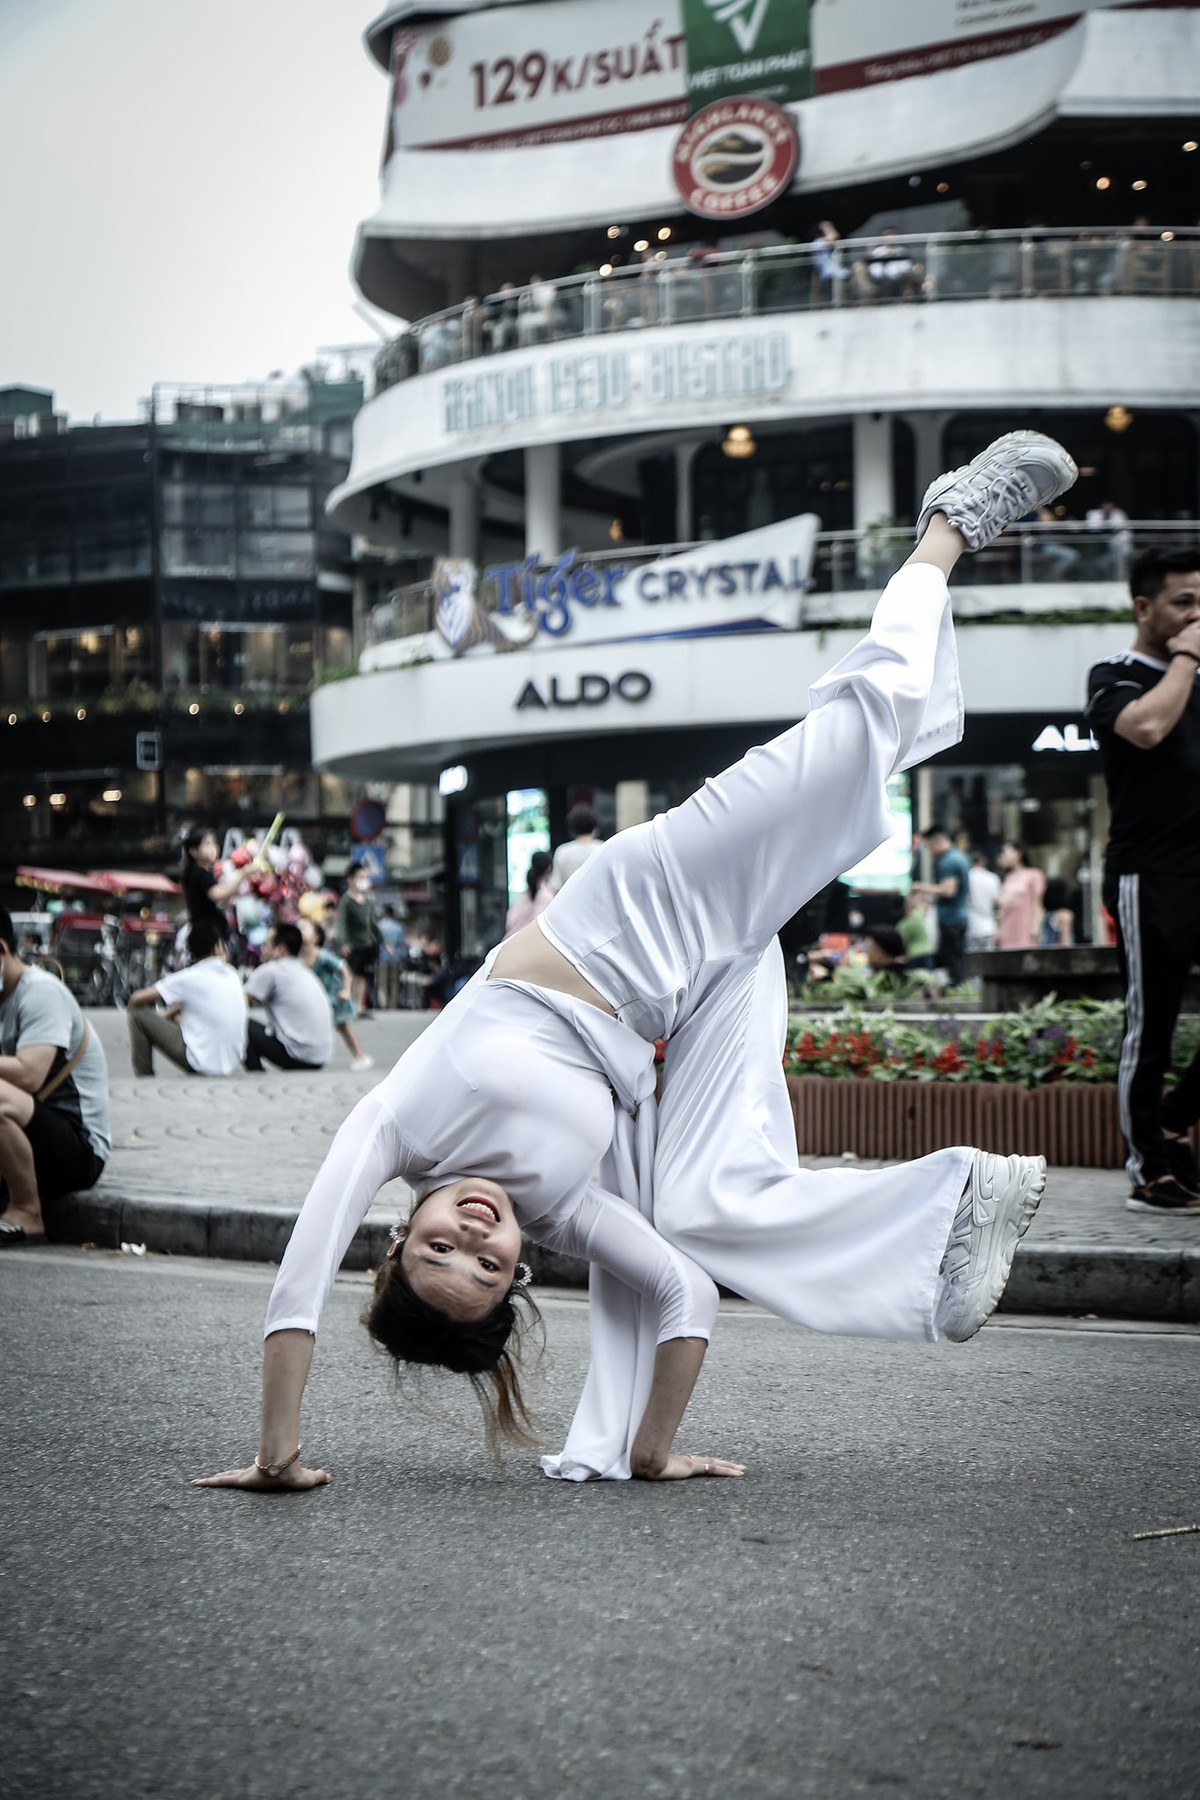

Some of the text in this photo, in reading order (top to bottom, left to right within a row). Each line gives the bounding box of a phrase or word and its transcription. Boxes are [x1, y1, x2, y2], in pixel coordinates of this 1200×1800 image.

[469, 17, 685, 109] 129K/SUẤT
[690, 173, 777, 210] COFFEE
[650, 329, 793, 401] BISTRO
[484, 548, 817, 636] Tiger CRYSTAL
[515, 671, 653, 711] ALDO
[1031, 723, 1100, 752] AL
